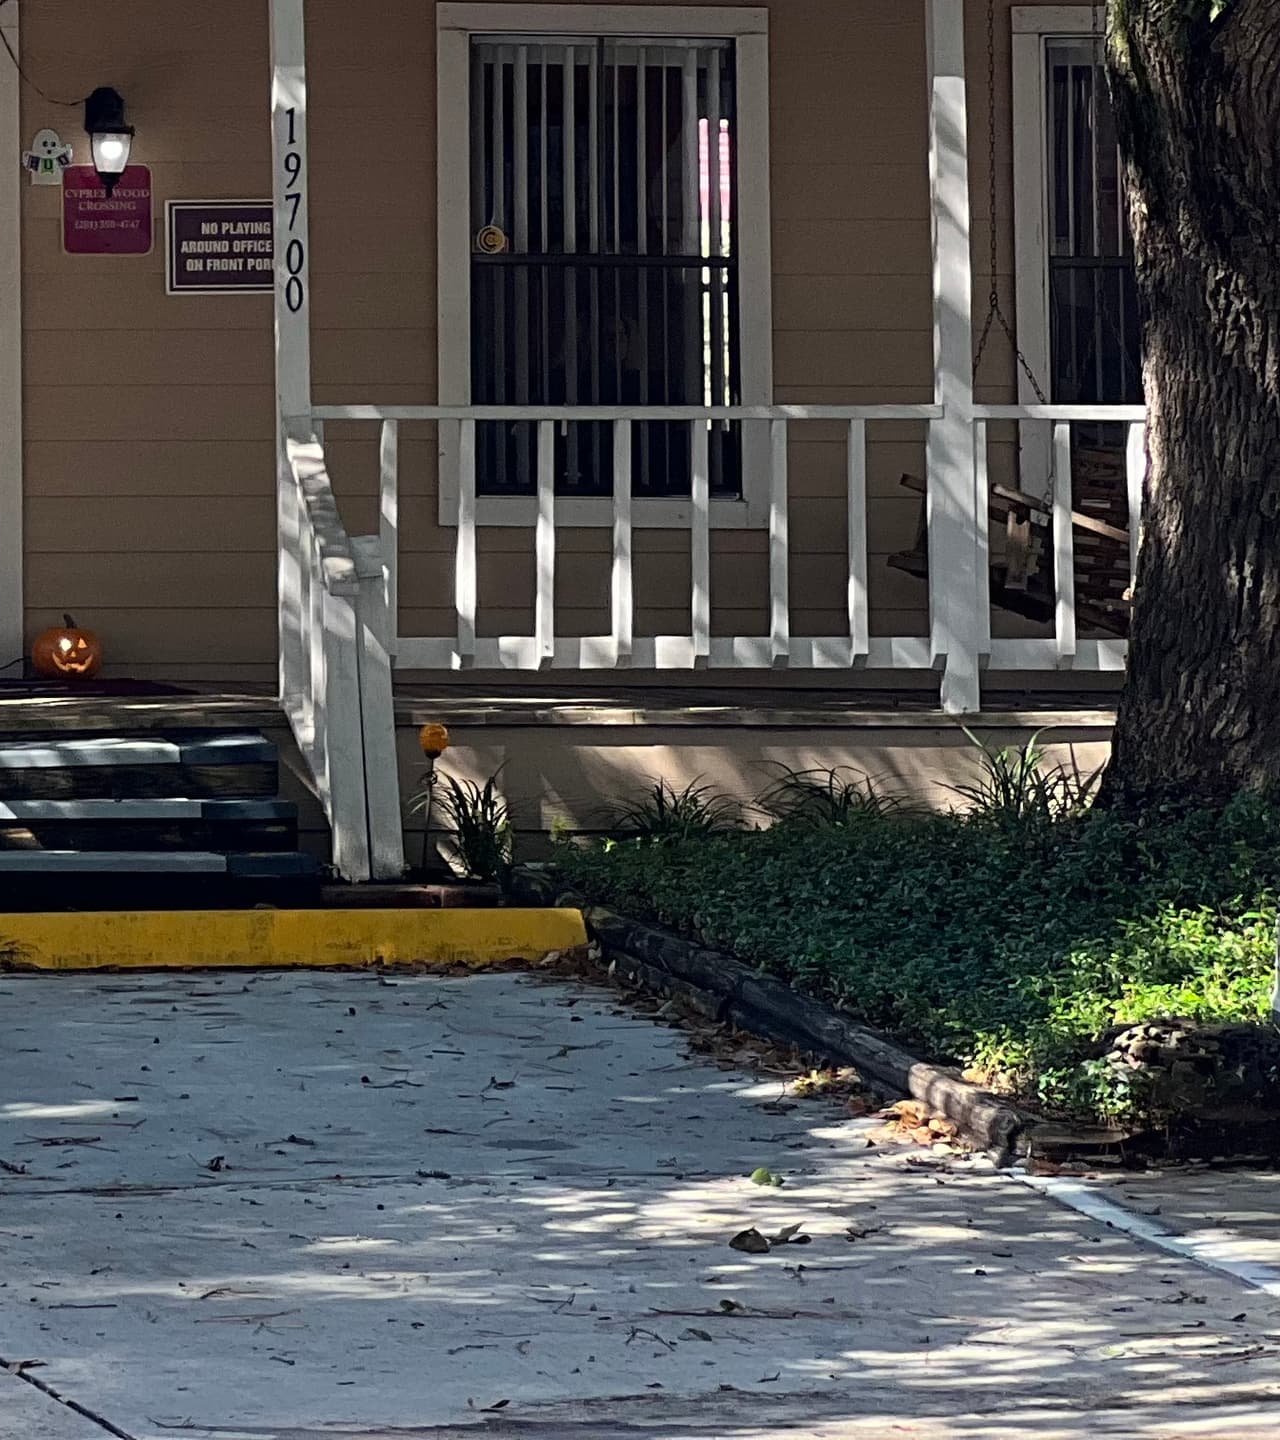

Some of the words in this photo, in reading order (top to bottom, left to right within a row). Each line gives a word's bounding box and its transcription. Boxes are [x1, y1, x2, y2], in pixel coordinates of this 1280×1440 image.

[64, 188, 150, 199] CYPRESWOOD
[78, 200, 137, 211] CROSSING
[284, 107, 304, 312] 19700
[201, 222, 218, 235] NO
[221, 222, 271, 235] PLAYING
[180, 240, 229, 254] AROUND
[233, 240, 273, 253] OFFICE
[186, 258, 203, 272] ON
[206, 258, 244, 272] FRONT
[247, 258, 274, 271] POR
